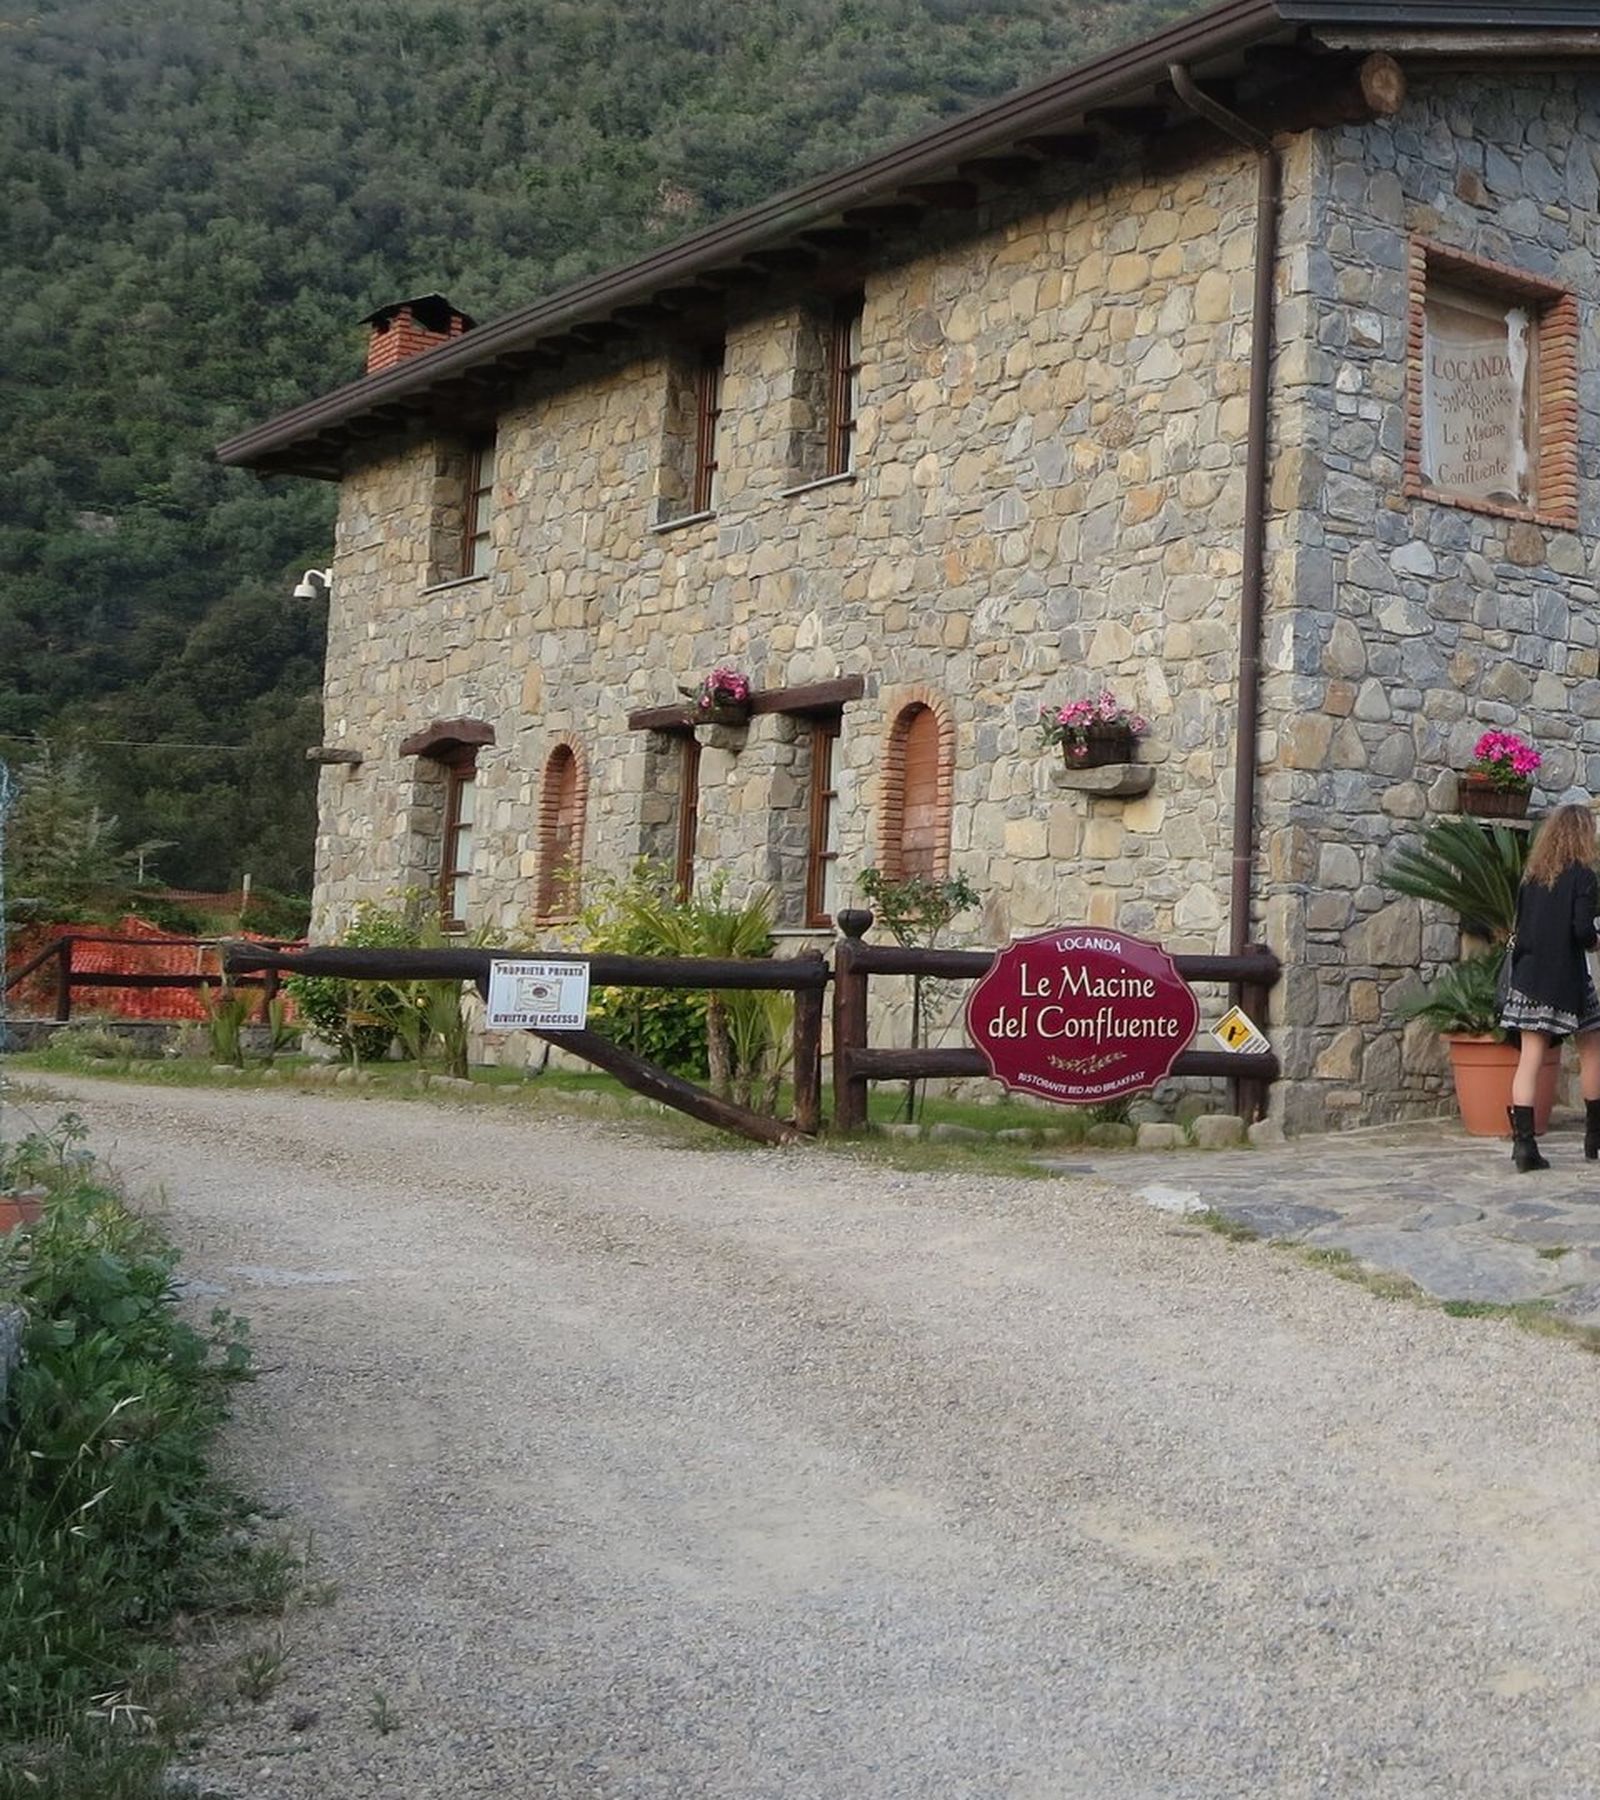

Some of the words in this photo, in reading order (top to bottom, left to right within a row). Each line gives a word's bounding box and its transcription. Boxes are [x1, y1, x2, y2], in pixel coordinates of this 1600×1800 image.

[1432, 355, 1513, 381] LOCANDA
[1443, 423, 1460, 445] Le
[1465, 423, 1506, 445] Macine
[1462, 444, 1482, 462] del
[1438, 458, 1508, 485] Confluente
[1056, 936, 1122, 954] LOCANDA
[1019, 963, 1052, 998] Le
[1057, 965, 1156, 1000] Macine
[493, 1014, 527, 1023] DIVIETO
[540, 1014, 579, 1023] ACCESSO
[988, 1006, 1028, 1039] del
[1036, 1006, 1180, 1045] Confluente
[1017, 1073, 1066, 1093] RISTORANTE
[1067, 1085, 1084, 1095] BED
[1085, 1084, 1103, 1094] AND
[1103, 1071, 1146, 1093] BREAKFAST
